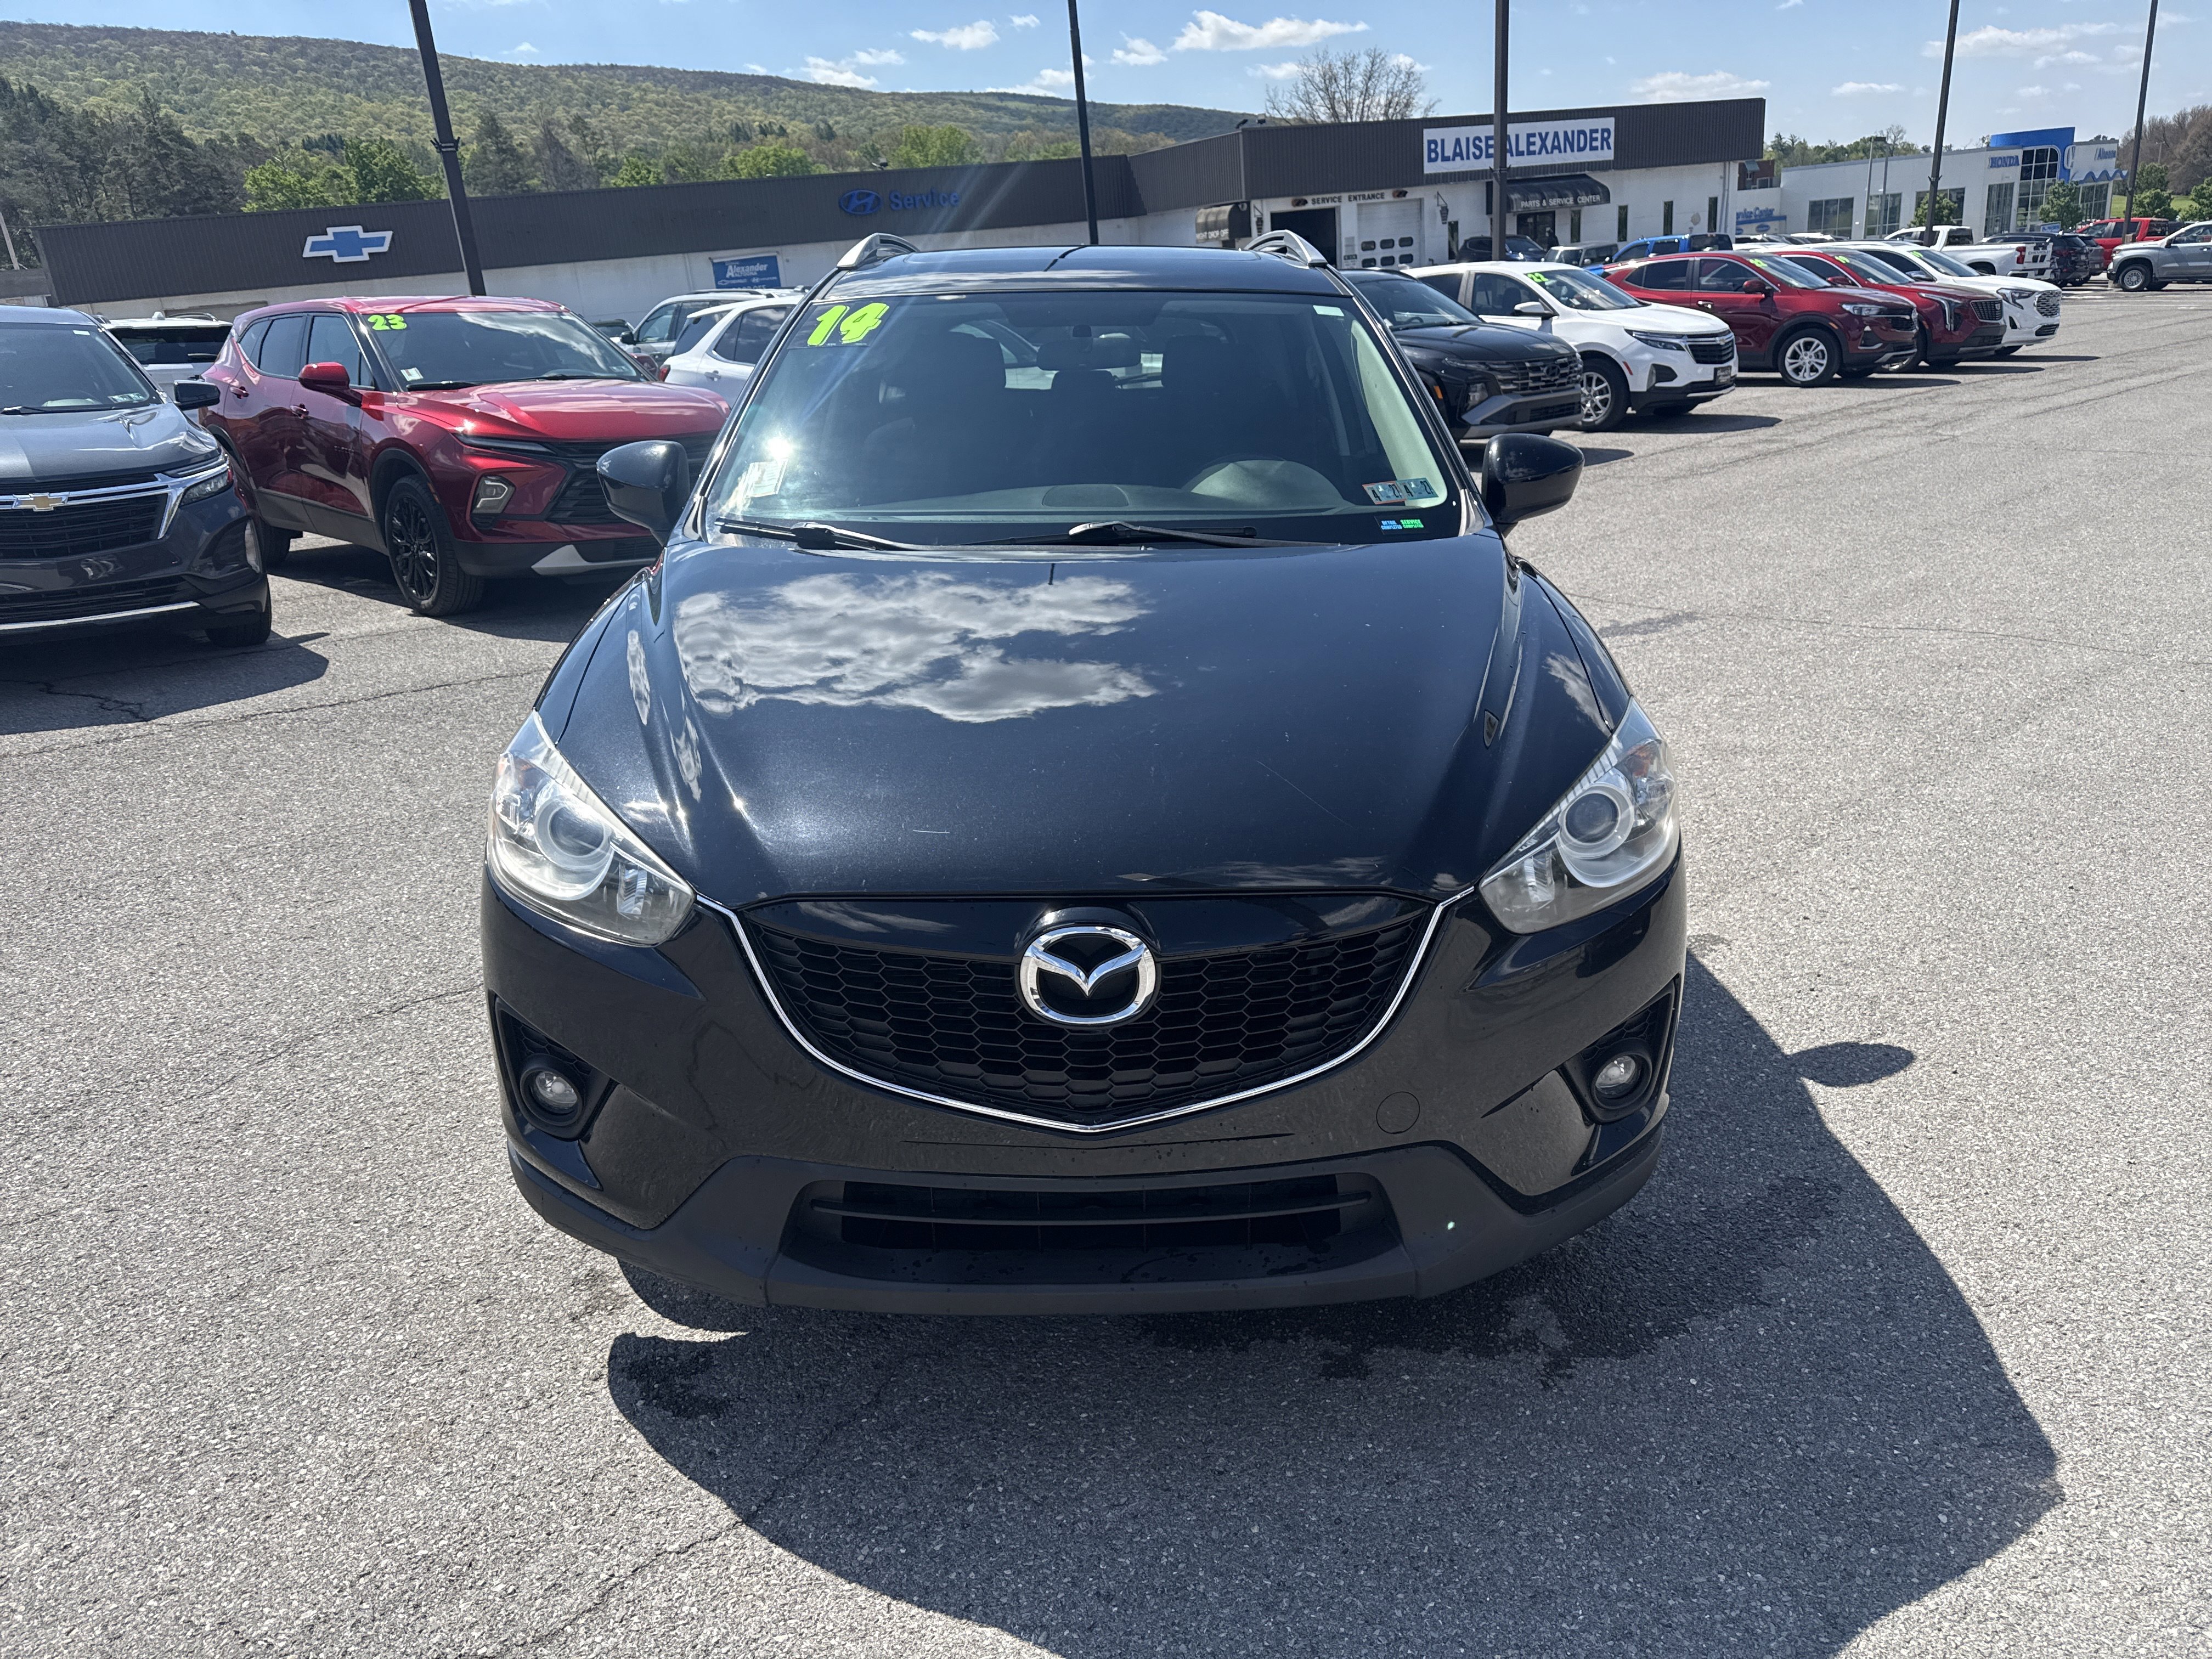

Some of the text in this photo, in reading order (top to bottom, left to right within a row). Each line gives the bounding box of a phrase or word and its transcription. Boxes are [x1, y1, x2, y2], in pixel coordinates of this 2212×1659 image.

[1427, 127, 1612, 163] BLAISE ALEXANDER
[1990, 155, 2019, 168] HONDA
[889, 188, 960, 211] Service
[1311, 192, 1385, 205] SERVICE ENTRANCE
[1521, 199, 1540, 208] PARTS
[1549, 197, 1574, 206] SERVICE
[1577, 195, 1601, 204] CENTER
[726, 263, 768, 278] Alexander
[1527, 273, 1549, 283] 22
[367, 314, 408, 330] 23
[807, 303, 890, 346] 14
